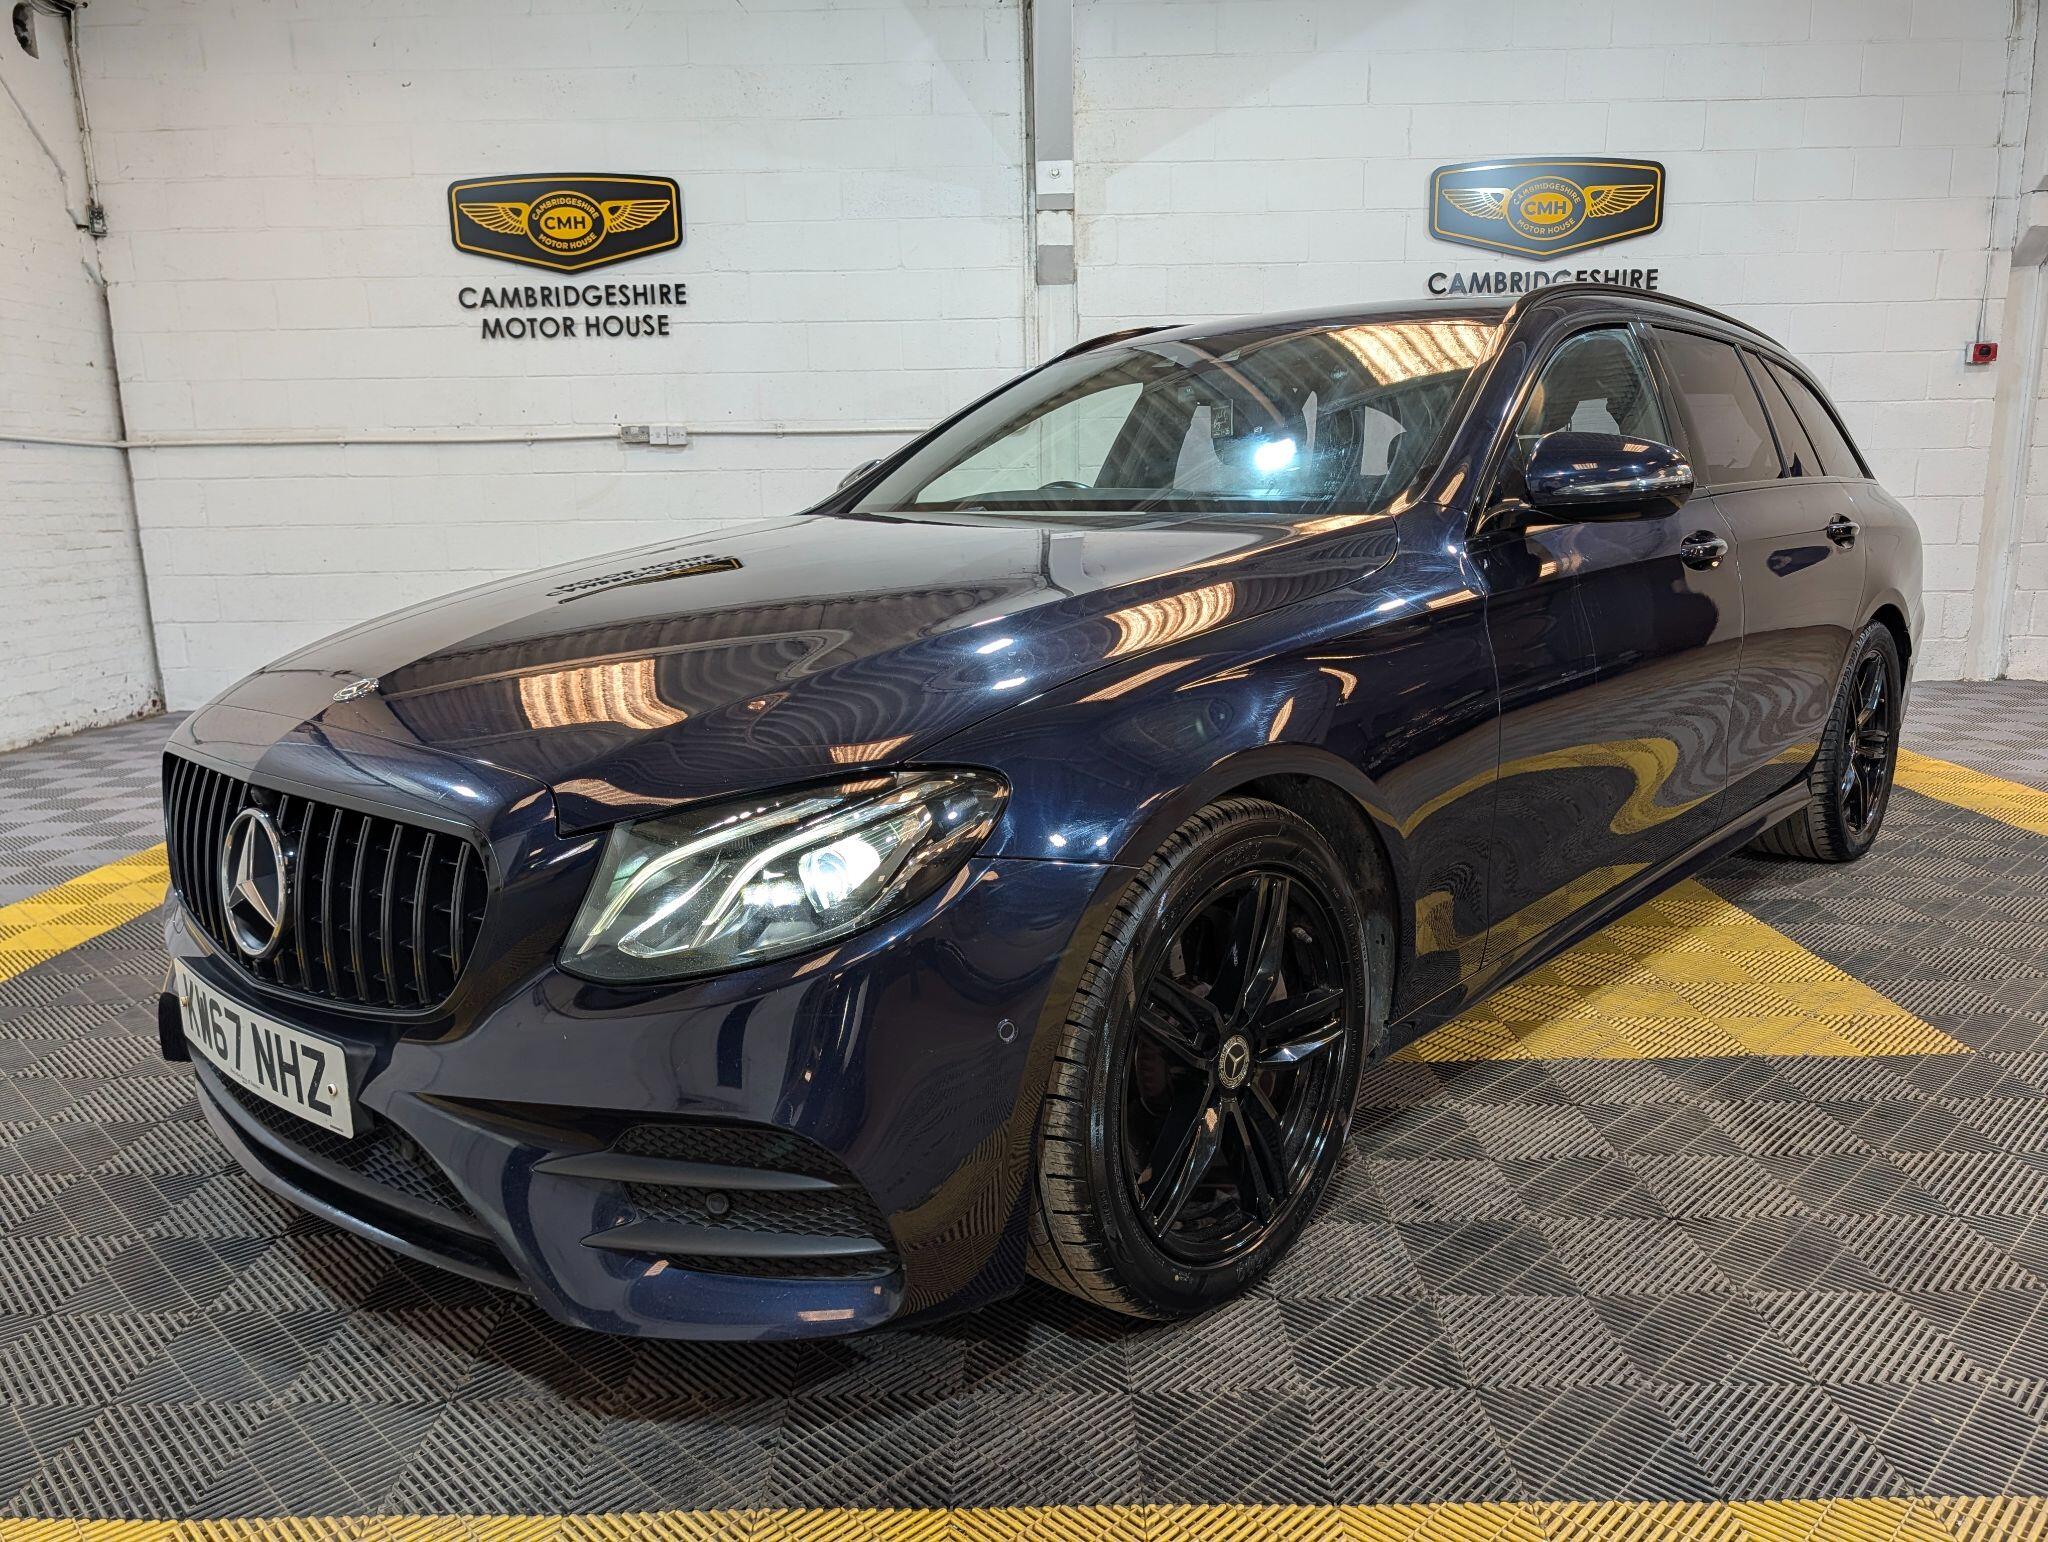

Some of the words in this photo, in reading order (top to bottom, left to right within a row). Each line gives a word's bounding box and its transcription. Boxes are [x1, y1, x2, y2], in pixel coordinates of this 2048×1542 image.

[1513, 182, 1581, 205] CAMBRIDGESHIRE
[531, 197, 600, 220] CAMBRIDGESHIRE
[1524, 201, 1567, 215] CMH
[544, 216, 586, 230] CMH
[1517, 219, 1546, 235] MOTOR
[1547, 217, 1576, 235] HOUSE
[538, 233, 569, 249] MOTOR
[569, 231, 598, 250] HOUSE
[458, 283, 687, 309] CAMBRIDGESHIRE
[481, 316, 576, 340] MOTOR
[585, 314, 670, 338] HOUSE
[183, 974, 241, 1072] KW67
[250, 1021, 333, 1118] NHZ
